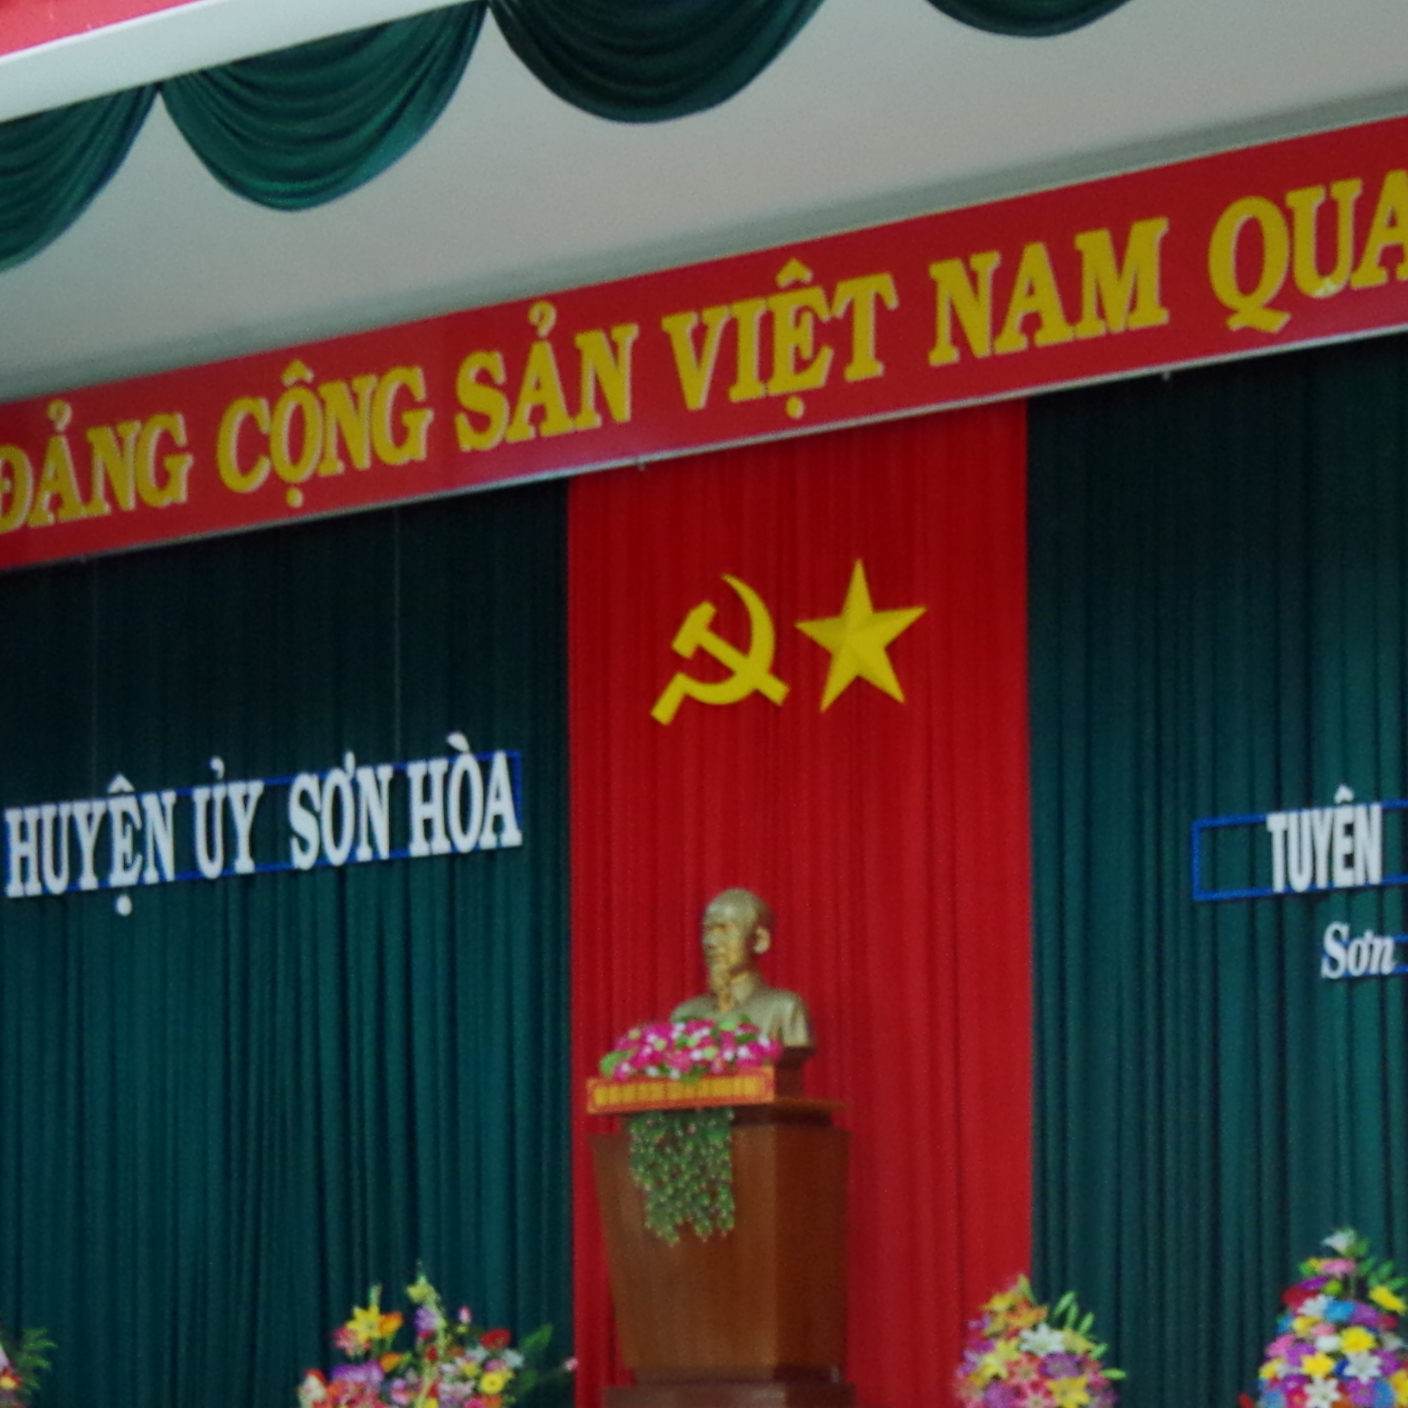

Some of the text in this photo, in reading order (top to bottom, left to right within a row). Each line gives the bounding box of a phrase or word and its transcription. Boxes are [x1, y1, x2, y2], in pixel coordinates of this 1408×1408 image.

[215, 358, 434, 507] CỘNG
[454, 301, 638, 453] SẢN
[661, 257, 899, 419] VIỆT
[927, 216, 1171, 368] NAM
[5, 731, 522, 916] HUYỆN ỦY SƠN HÒA
[1266, 784, 1382, 893] TUYÊN
[1320, 921, 1397, 980] Sơn
